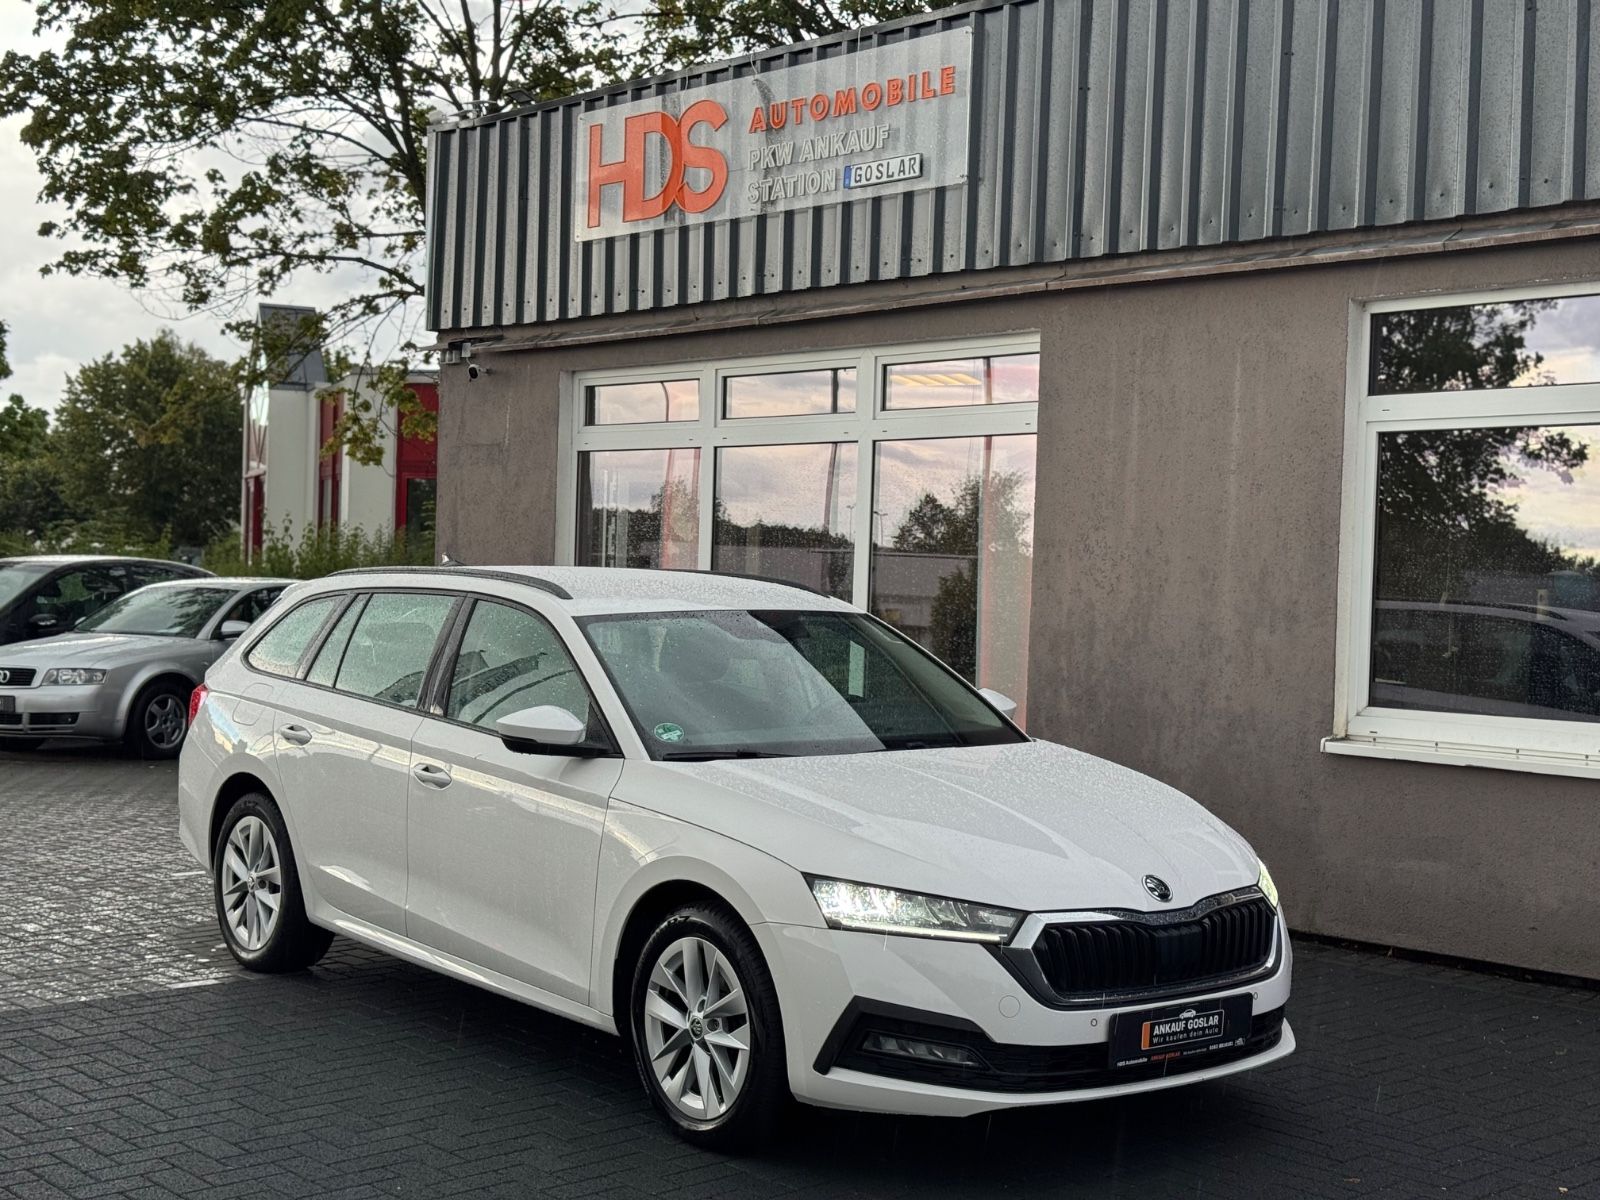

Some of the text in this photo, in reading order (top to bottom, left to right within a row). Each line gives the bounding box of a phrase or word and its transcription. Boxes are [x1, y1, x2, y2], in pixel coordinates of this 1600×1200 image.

[748, 65, 956, 134] AUTOMOBILE
[587, 99, 729, 228] HDS
[748, 123, 890, 171] PKW ANKAUF
[747, 157, 917, 204] STATION GOSLAR
[1152, 1027, 1219, 1044] Wir kaufen dein Auto
[1153, 1015, 1219, 1036] ANKAUF GOSLAR
